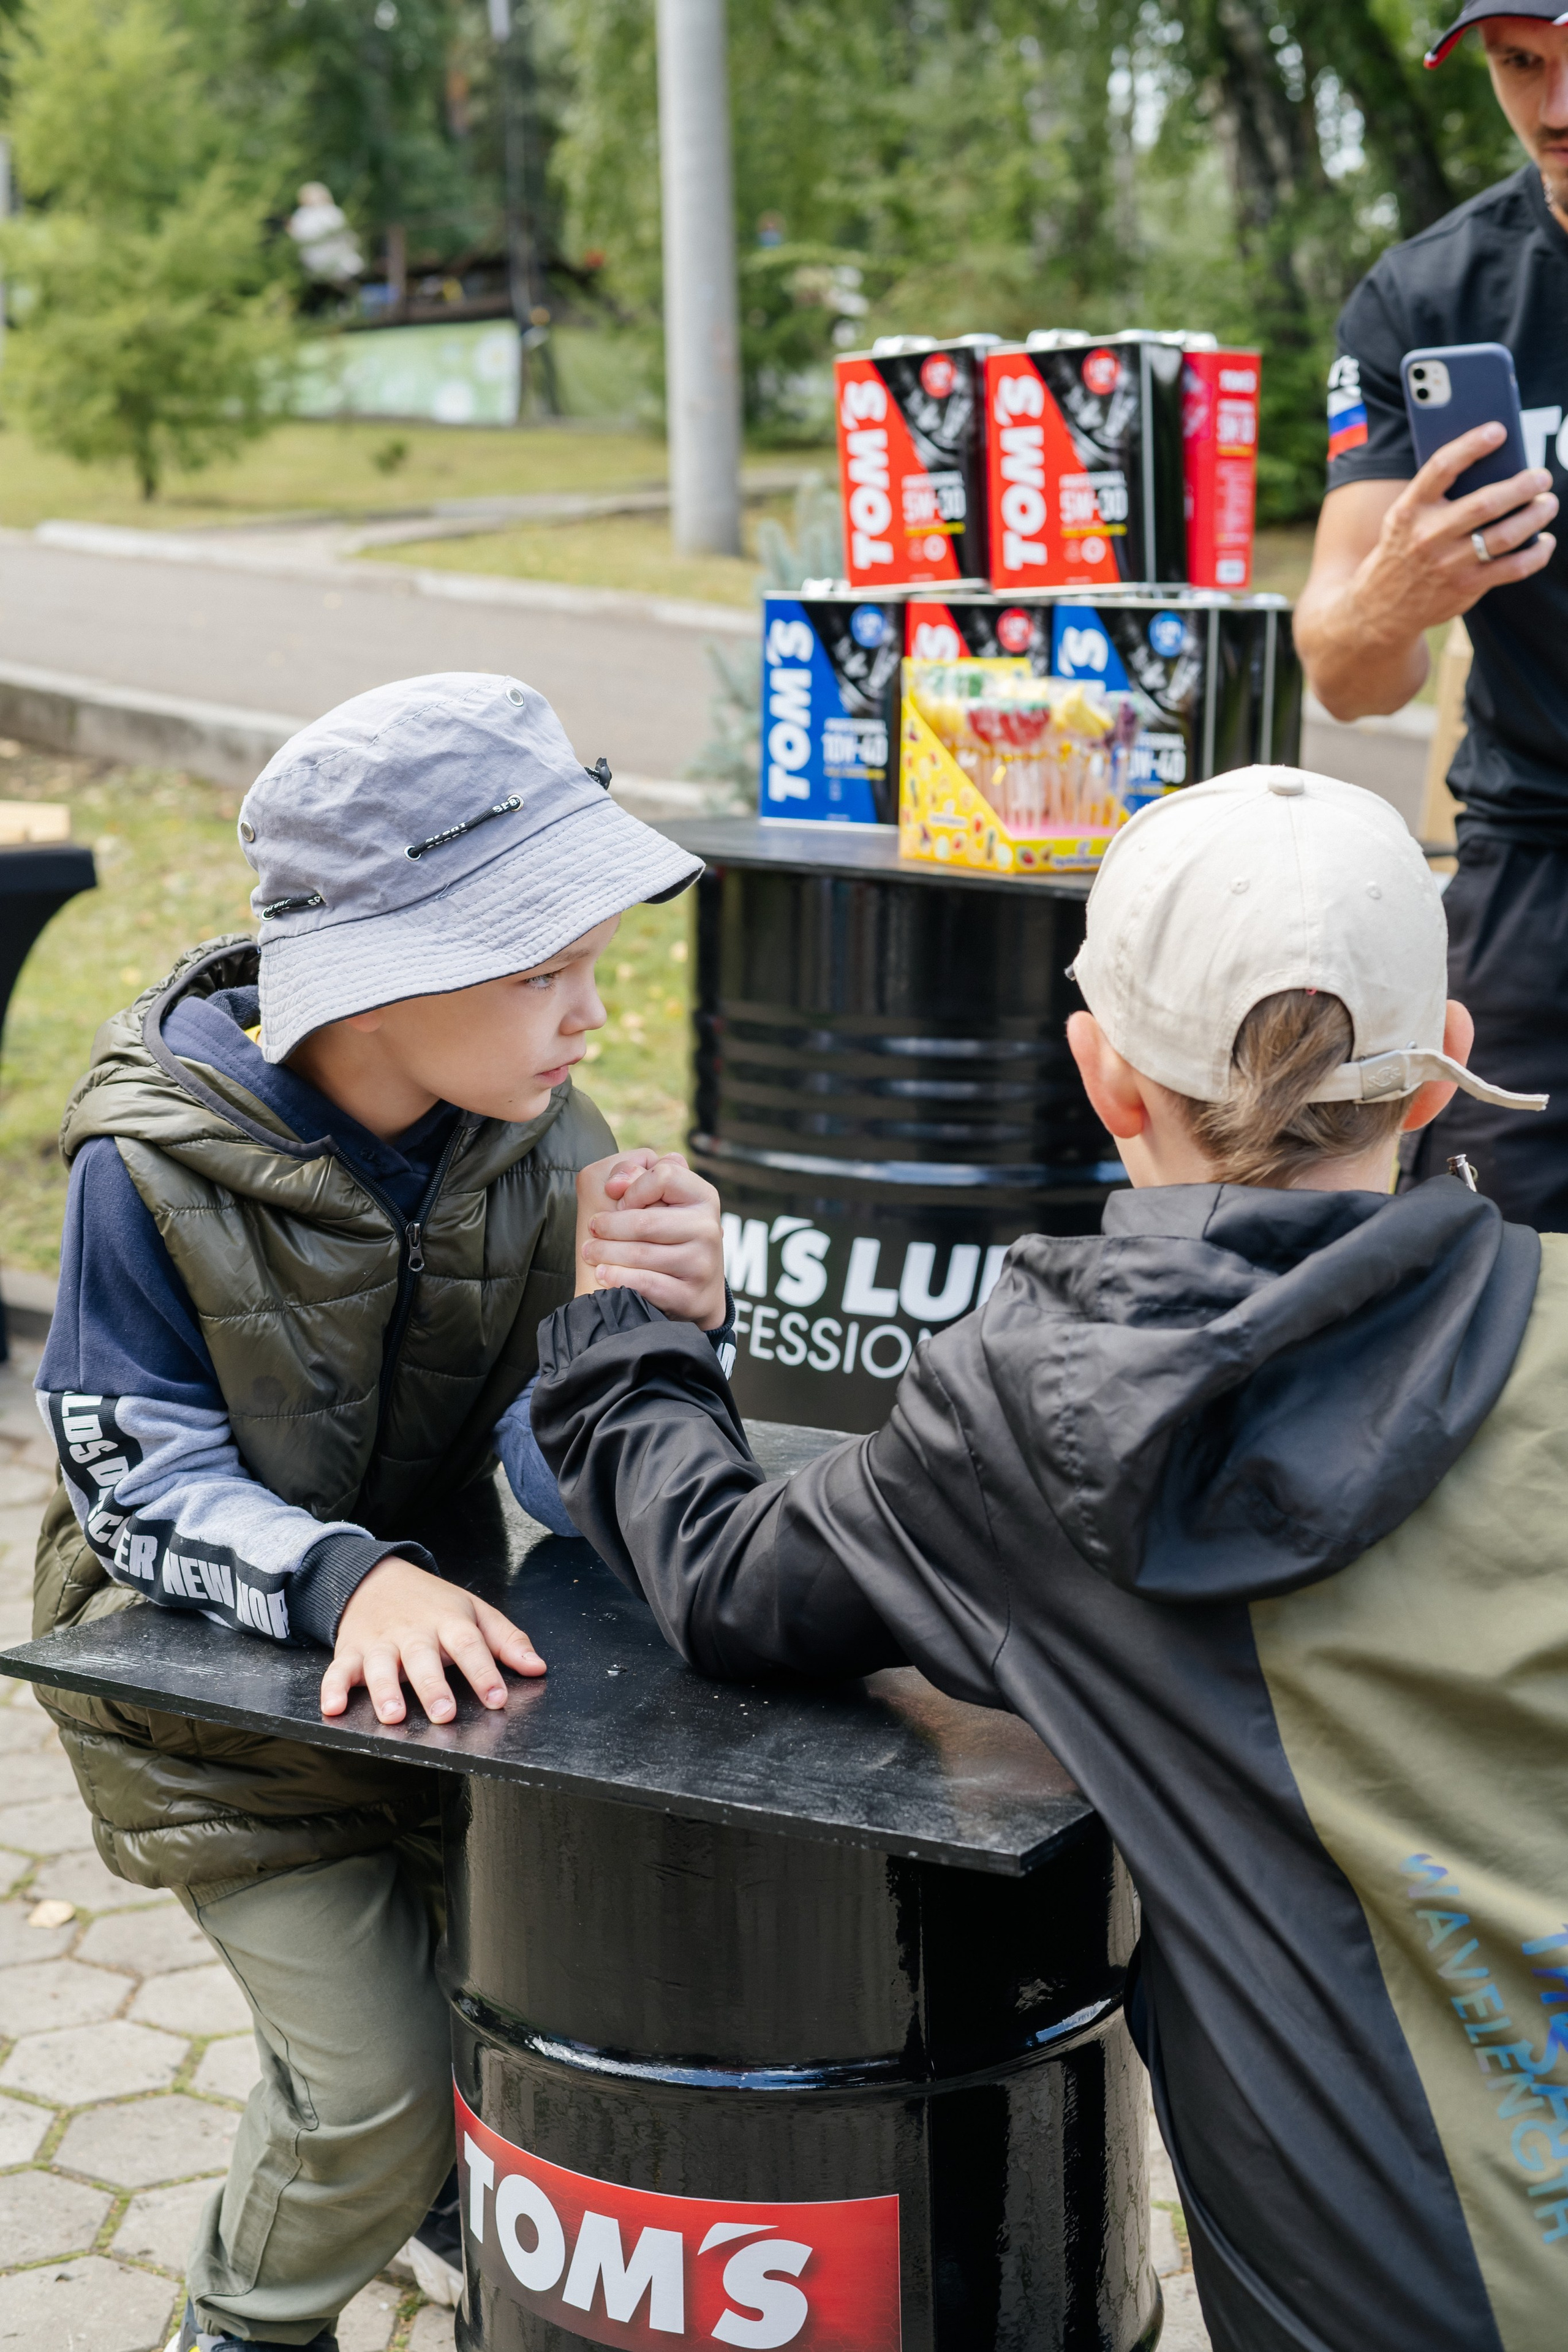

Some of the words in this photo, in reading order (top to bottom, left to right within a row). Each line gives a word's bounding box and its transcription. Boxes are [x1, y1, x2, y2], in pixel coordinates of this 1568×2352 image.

[841, 380, 894, 570] TOM'S
[994, 374, 1048, 571] TOM'S
[766, 619, 814, 802] TOM'S
[162, 1548, 235, 1609] NEW
[464, 2130, 813, 2350] TOM'S
